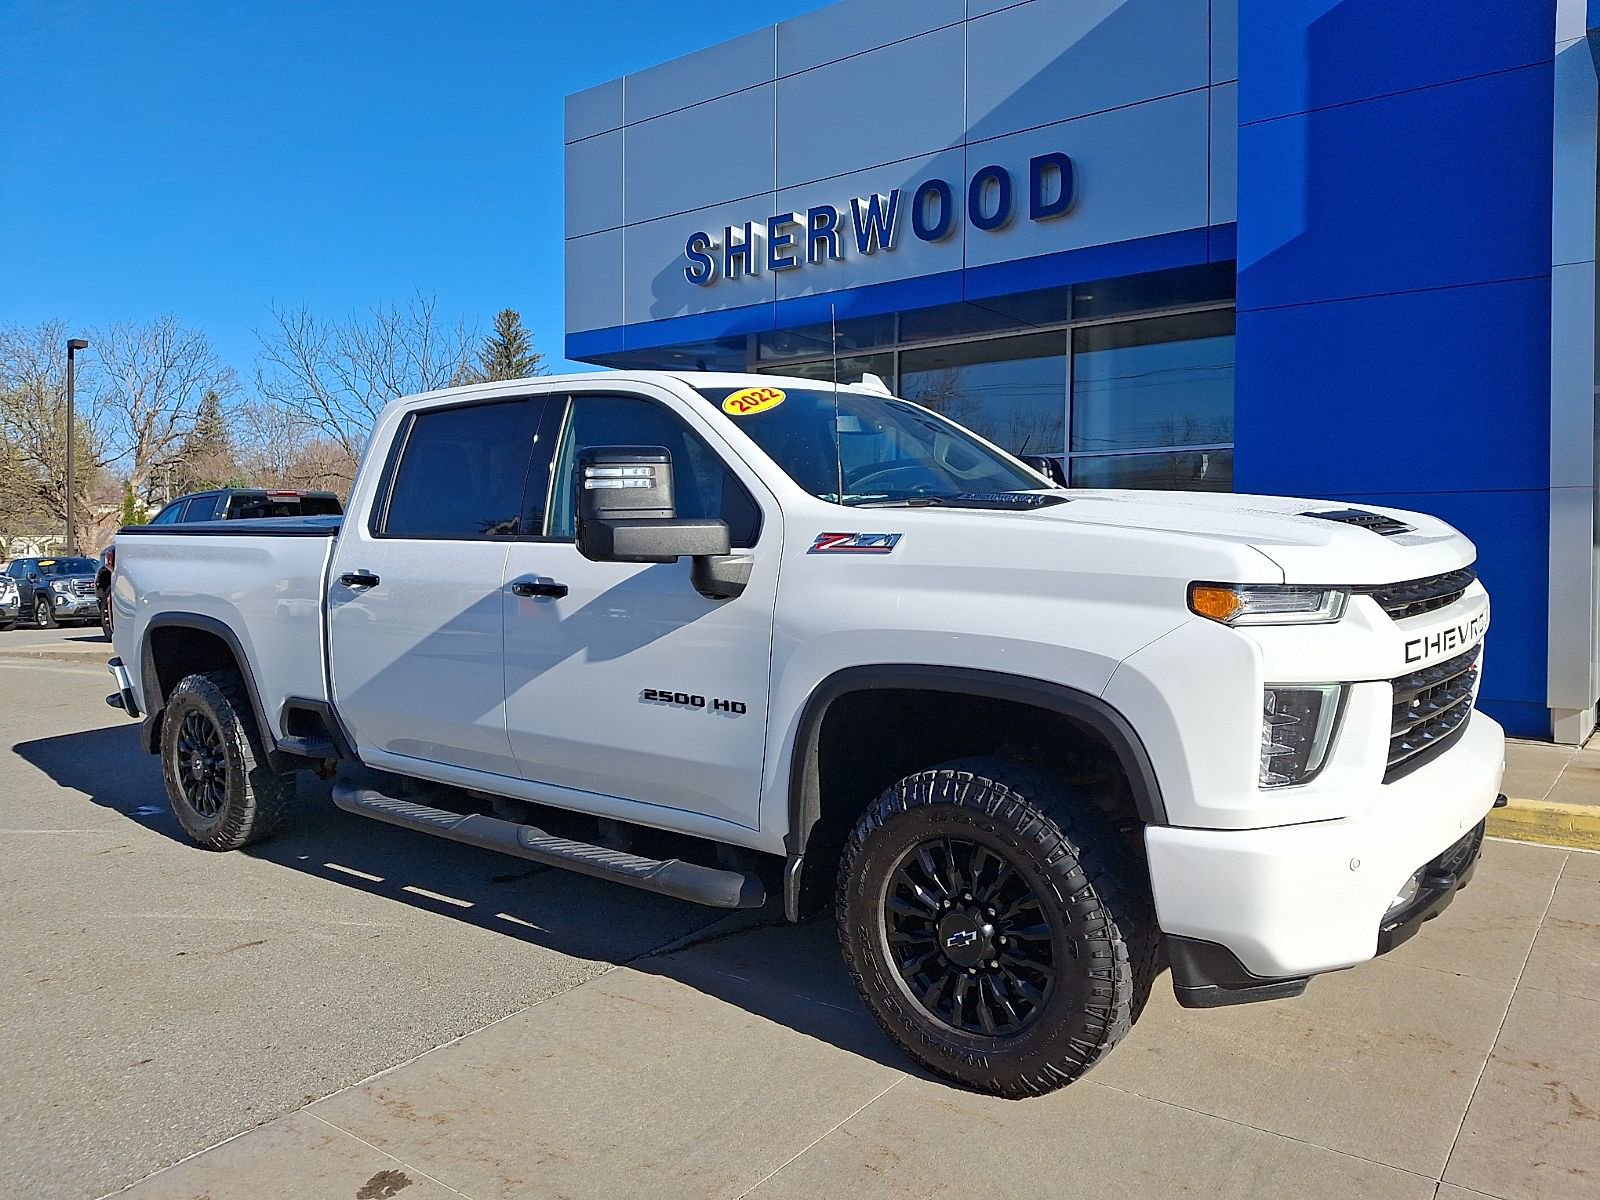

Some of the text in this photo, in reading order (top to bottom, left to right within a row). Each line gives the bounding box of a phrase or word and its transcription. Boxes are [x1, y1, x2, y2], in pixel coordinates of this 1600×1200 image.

[684, 152, 1075, 286] SHERWOOD
[731, 388, 780, 412] 2022
[806, 532, 903, 554] Z71
[643, 688, 747, 715] 2500 HD
